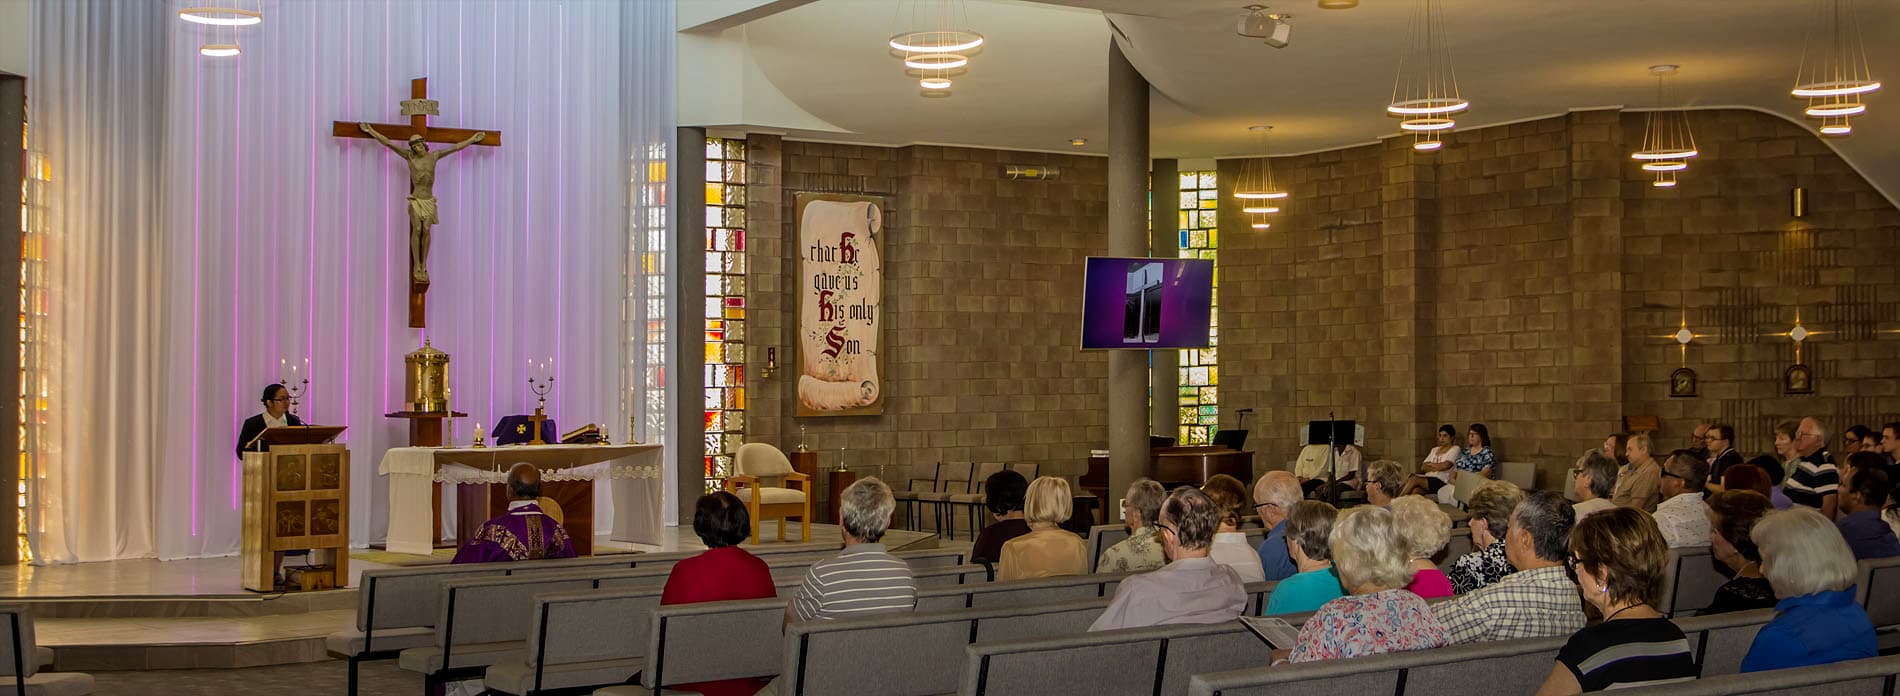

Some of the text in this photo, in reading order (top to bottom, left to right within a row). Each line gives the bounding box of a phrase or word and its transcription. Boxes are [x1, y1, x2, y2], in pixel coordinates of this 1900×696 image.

[814, 273, 858, 295] gave us
[849, 298, 873, 326] only
[821, 326, 860, 358] Son
